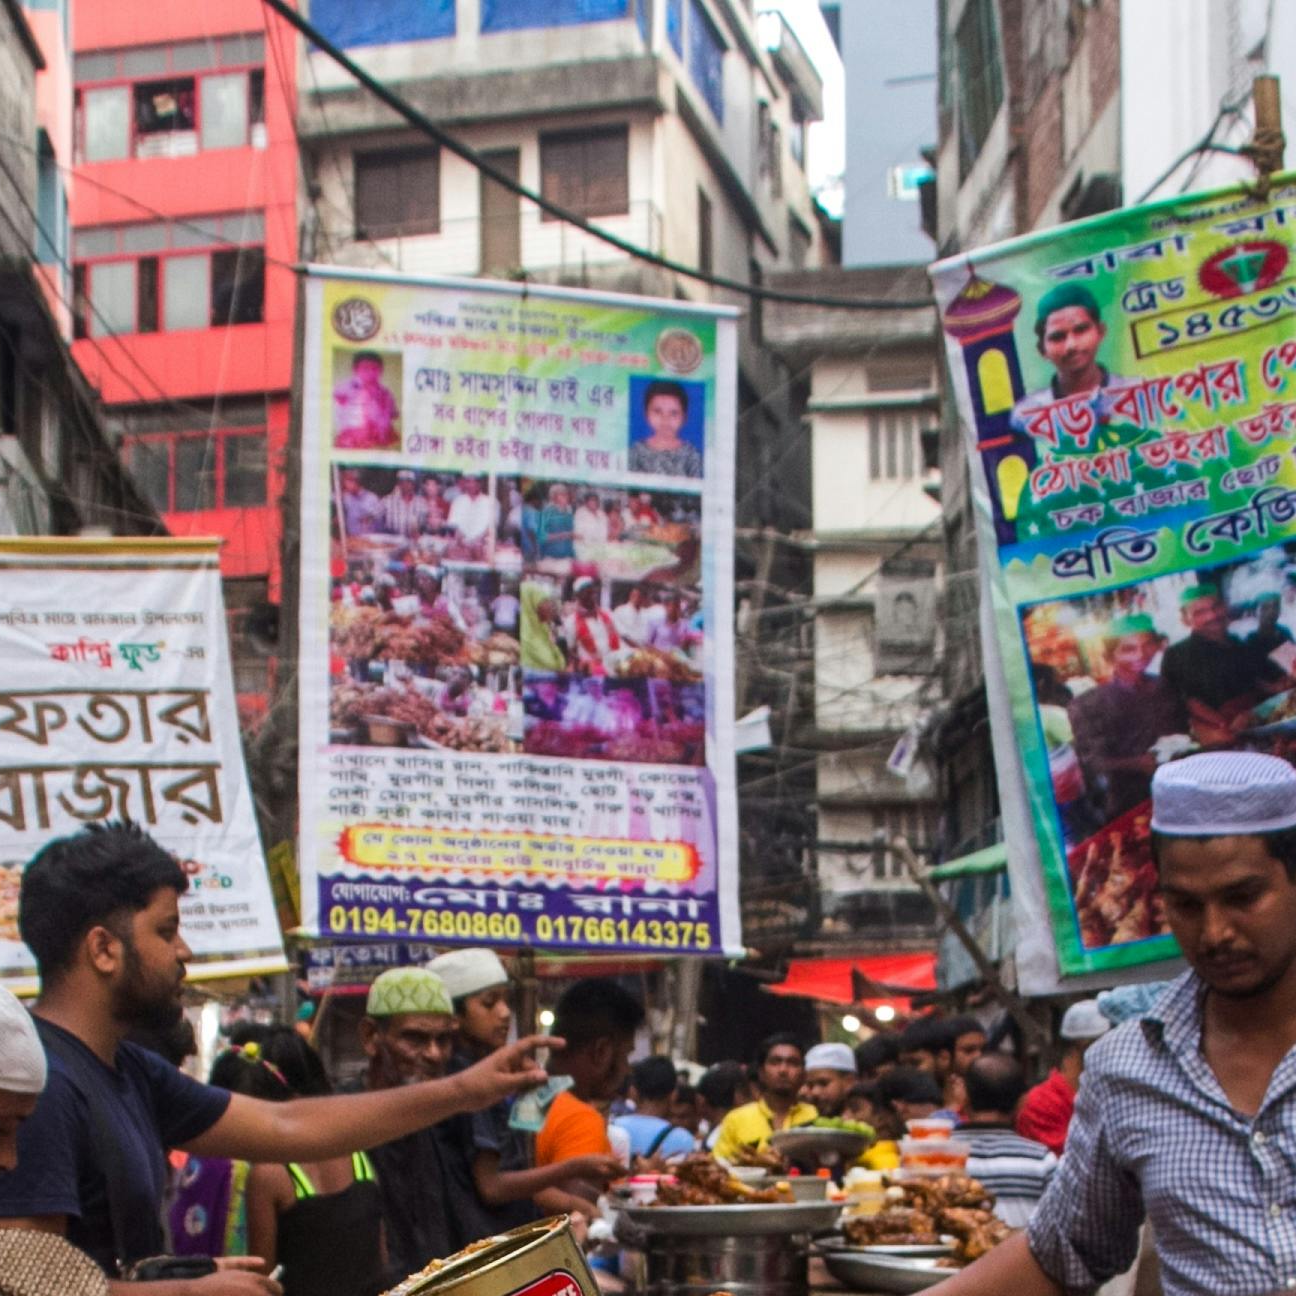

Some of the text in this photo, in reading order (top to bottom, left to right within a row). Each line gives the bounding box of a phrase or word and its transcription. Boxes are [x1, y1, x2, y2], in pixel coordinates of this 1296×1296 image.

[1121, 276, 1186, 314] ট্রেড
[414, 365, 453, 394] মোঃ
[545, 376, 581, 407] ভাই
[586, 382, 617, 408] এর
[1021, 393, 1098, 448] বড়
[1100, 359, 1244, 425] বাপের
[1137, 424, 1230, 472] ভইরা
[1048, 502, 1105, 531] চক
[1113, 478, 1211, 517] বাজার
[1220, 453, 1281, 492] ছোট
[1051, 526, 1160, 584] প্রতি
[47, 634, 114, 671] কান্ট্রি
[535, 916, 712, 951] 01766143375
